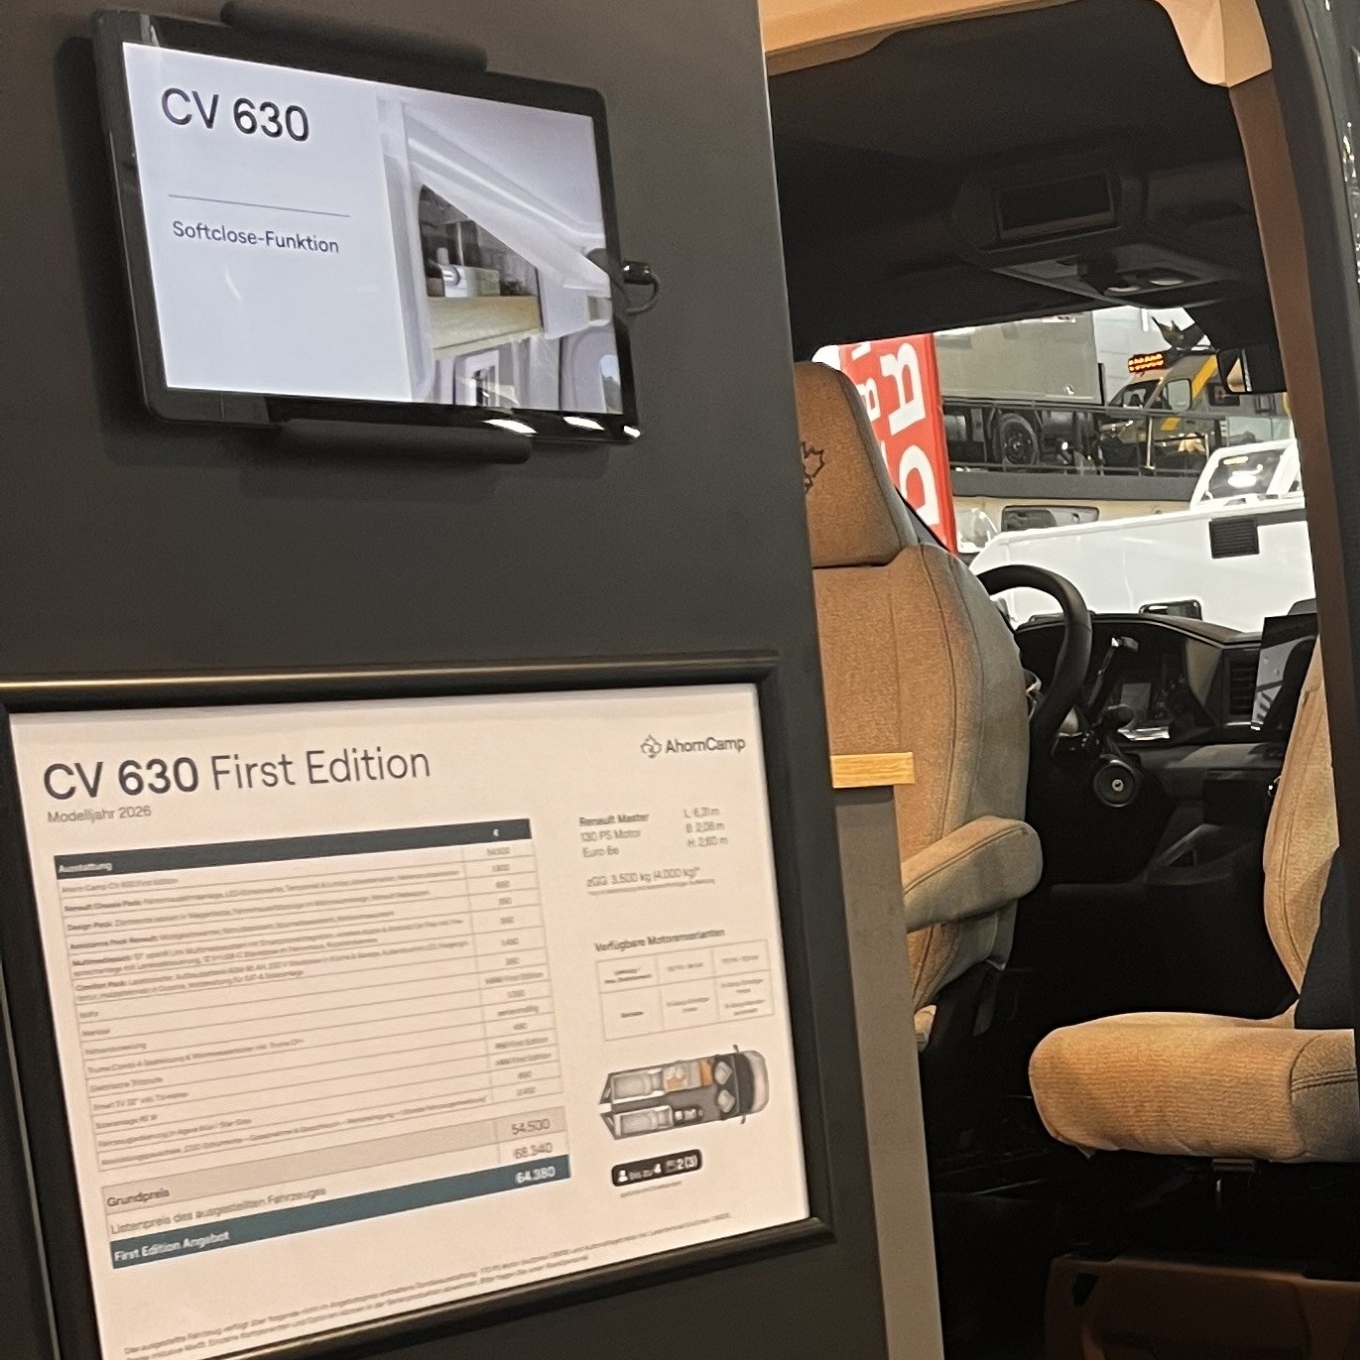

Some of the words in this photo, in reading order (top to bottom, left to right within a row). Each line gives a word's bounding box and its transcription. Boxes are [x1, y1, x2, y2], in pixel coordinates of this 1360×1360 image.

[161, 87, 219, 129] CV
[233, 98, 309, 142] 630
[172, 220, 340, 253] Softclose-Funktion
[665, 737, 747, 754] AhornCamp
[44, 761, 104, 800] CV
[118, 757, 199, 796] 630
[211, 753, 296, 791] First
[306, 746, 431, 785] Edition
[47, 807, 115, 824] Modelljahr
[119, 805, 152, 819] 2026
[579, 815, 617, 827] Renault
[618, 814, 650, 825] Master
[614, 828, 642, 840] Motor
[582, 847, 606, 858] Euro
[107, 1187, 171, 1208] Grundpreis
[114, 1248, 141, 1262] First
[141, 1239, 182, 1257] Edition
